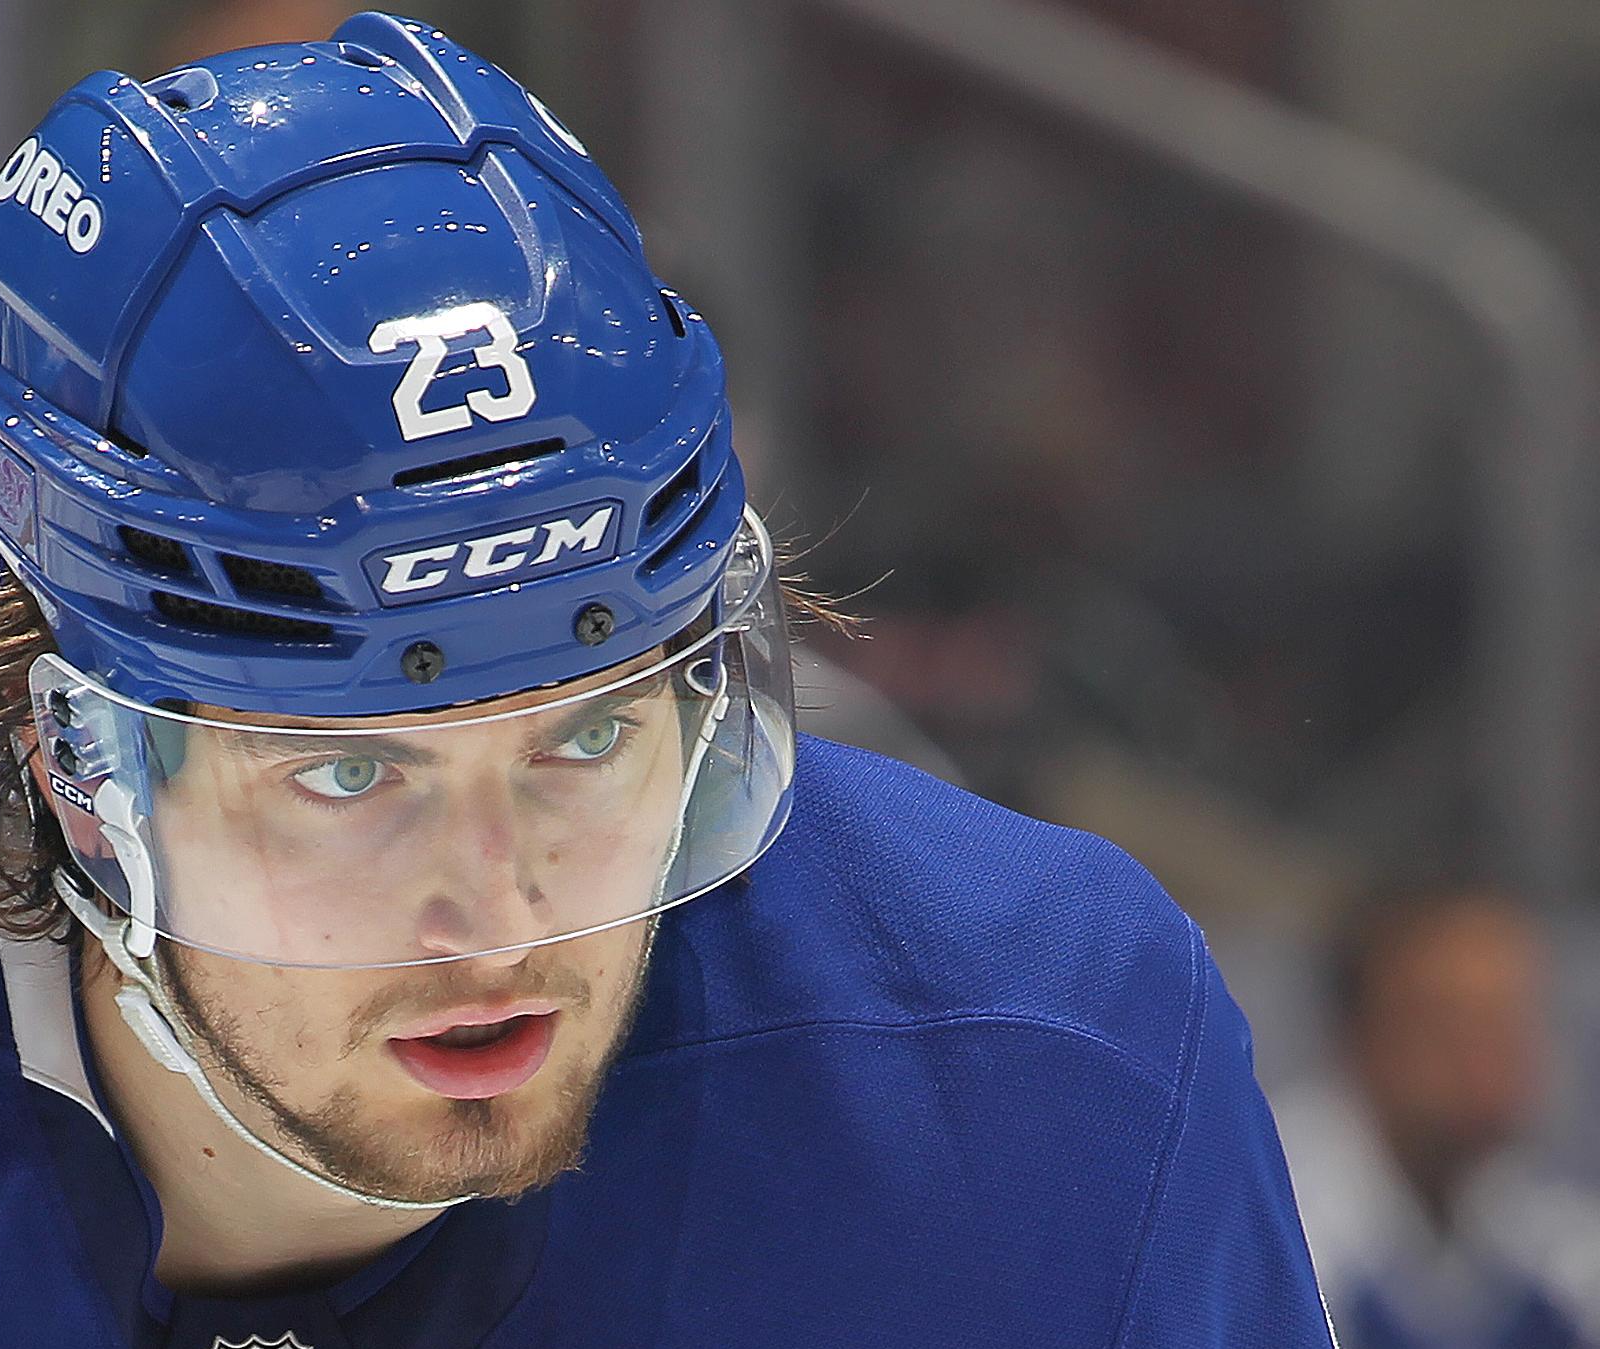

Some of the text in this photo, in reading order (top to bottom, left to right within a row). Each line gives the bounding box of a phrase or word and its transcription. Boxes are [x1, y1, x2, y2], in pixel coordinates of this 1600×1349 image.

[369, 303, 536, 440] 23
[381, 508, 616, 594] CCM
[51, 776, 93, 811] CCM
